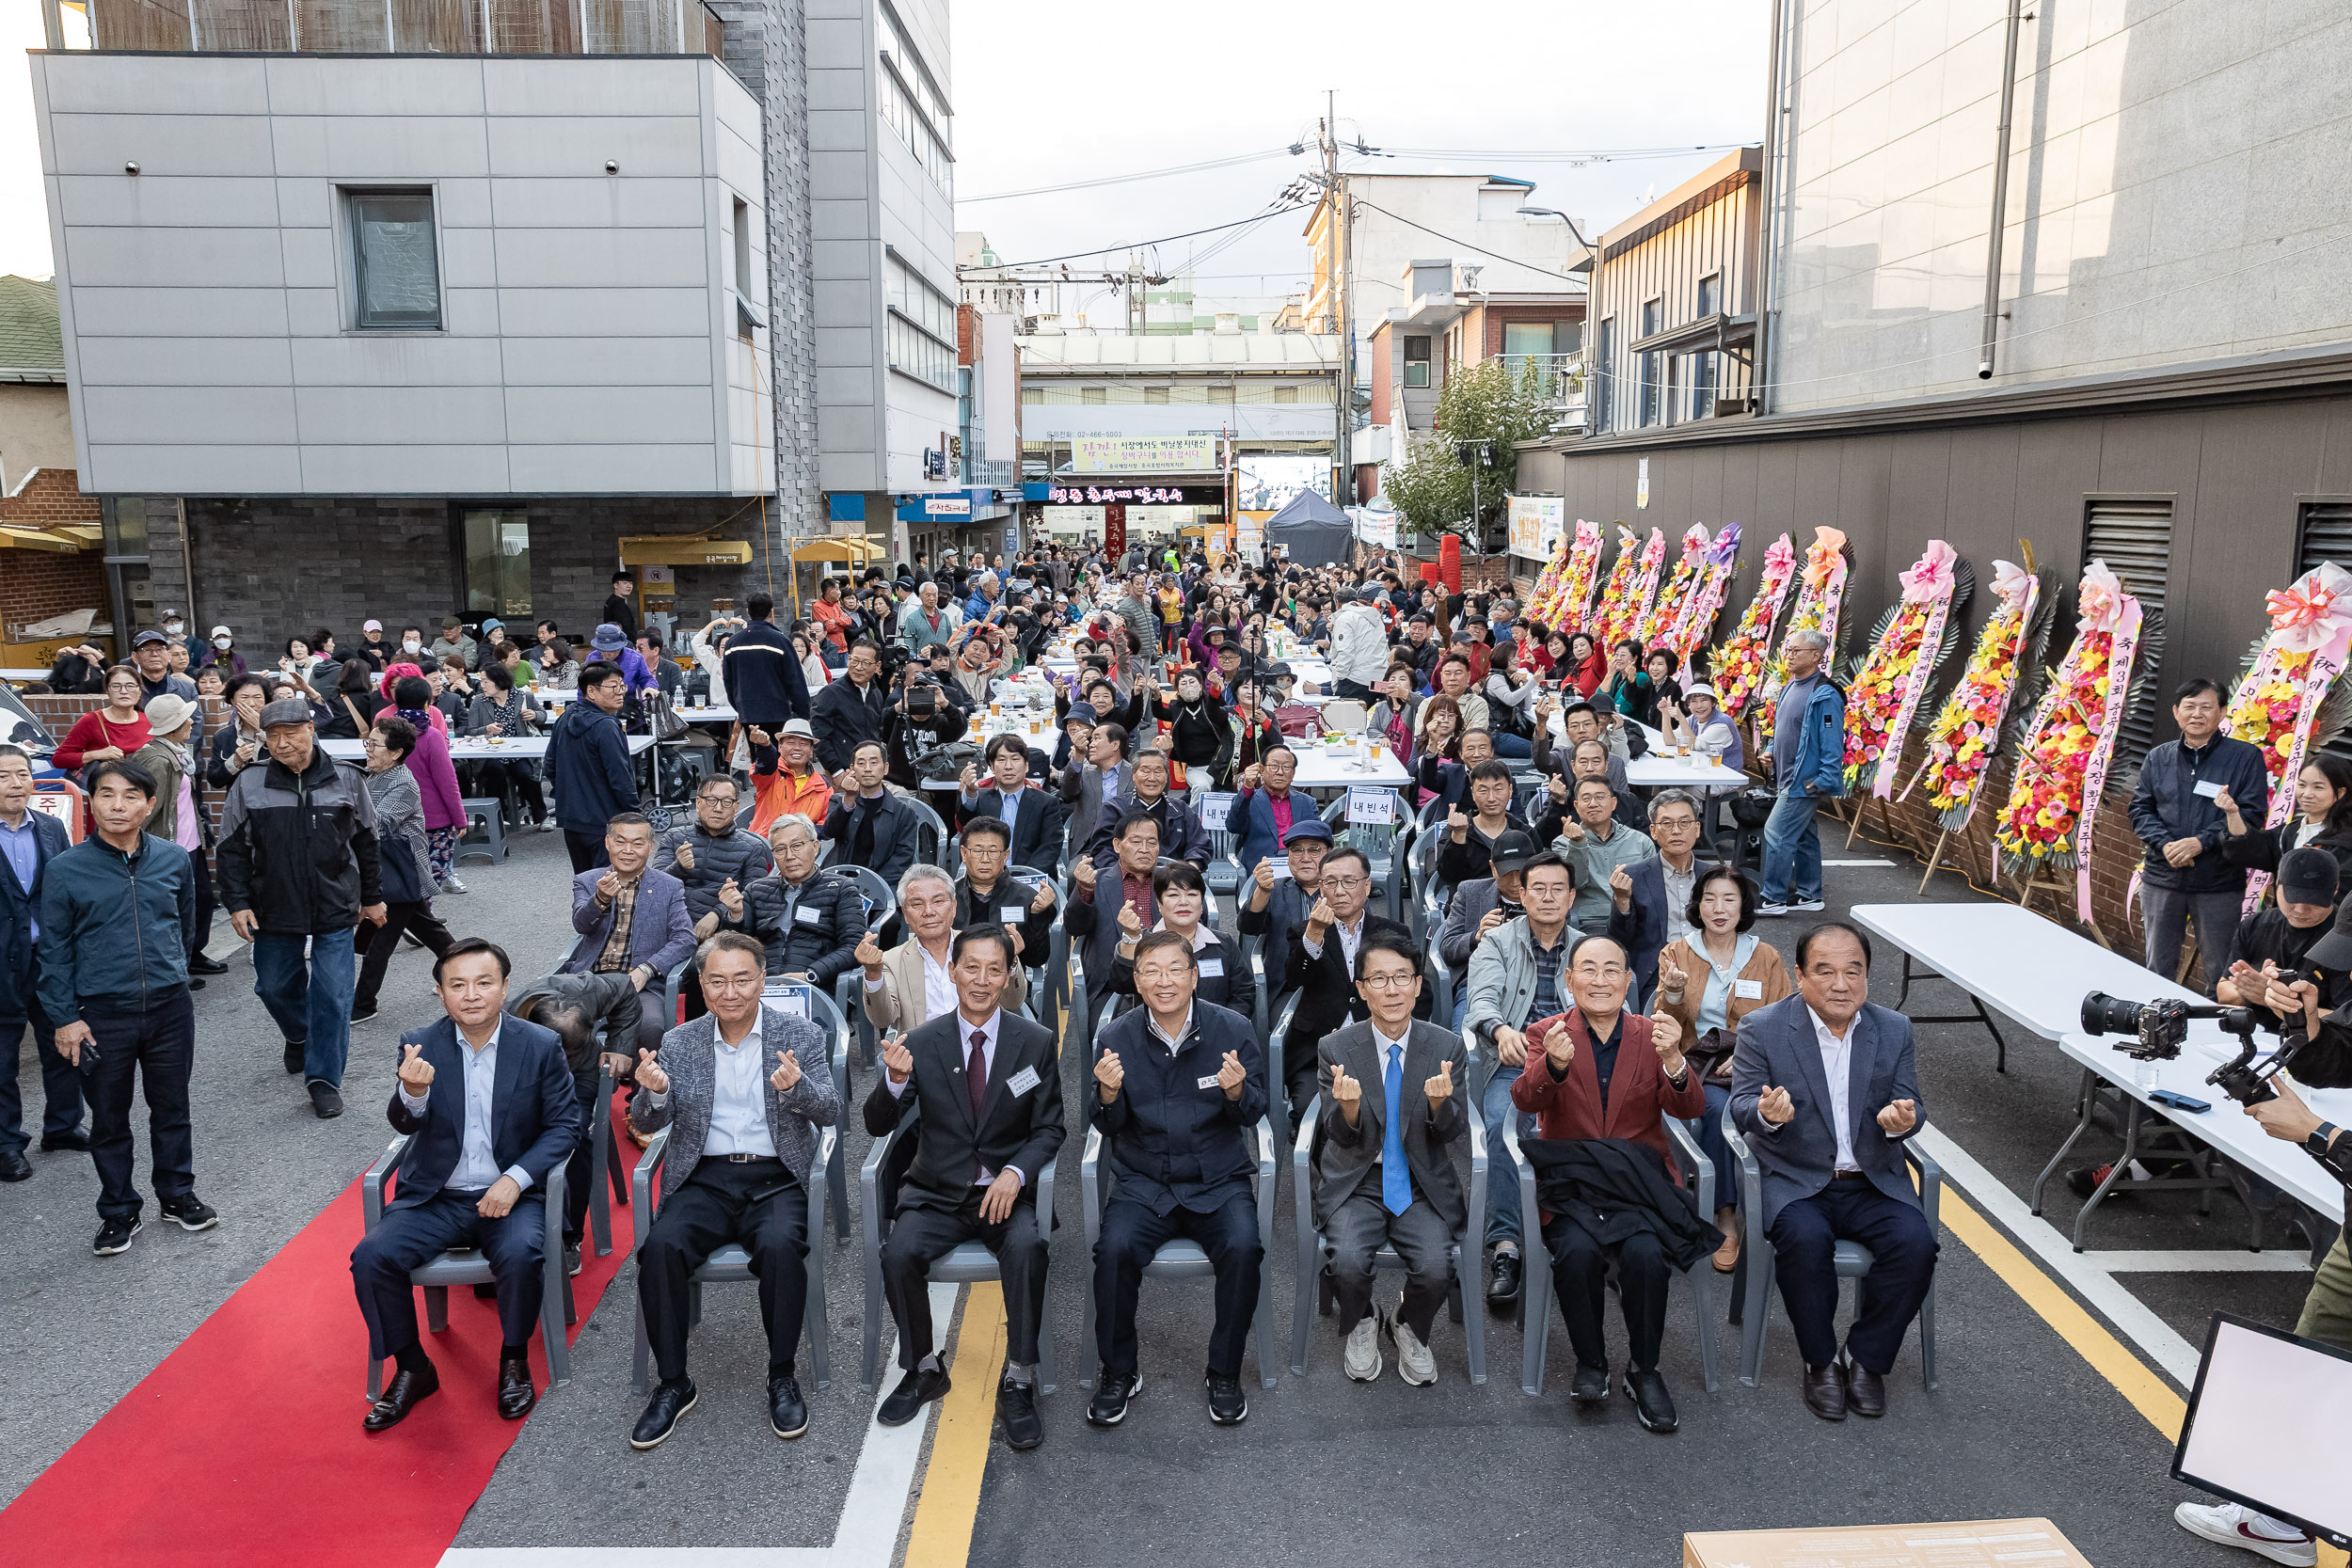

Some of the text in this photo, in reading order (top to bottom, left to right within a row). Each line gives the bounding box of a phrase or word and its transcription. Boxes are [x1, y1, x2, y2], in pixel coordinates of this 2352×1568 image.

[1082, 439, 1207, 457] 잠깐! 시장에서도 비닐봉지대신
[1121, 451, 1157, 461] 장바구니를
[1159, 451, 1174, 460] 이용
[1135, 485, 1184, 505] 칼국수
[1830, 583, 1842, 598] 축
[2297, 678, 2325, 726] 제3회
[2077, 637, 2134, 874] 축 제3회 중곡제일시장 황금맥주축제
